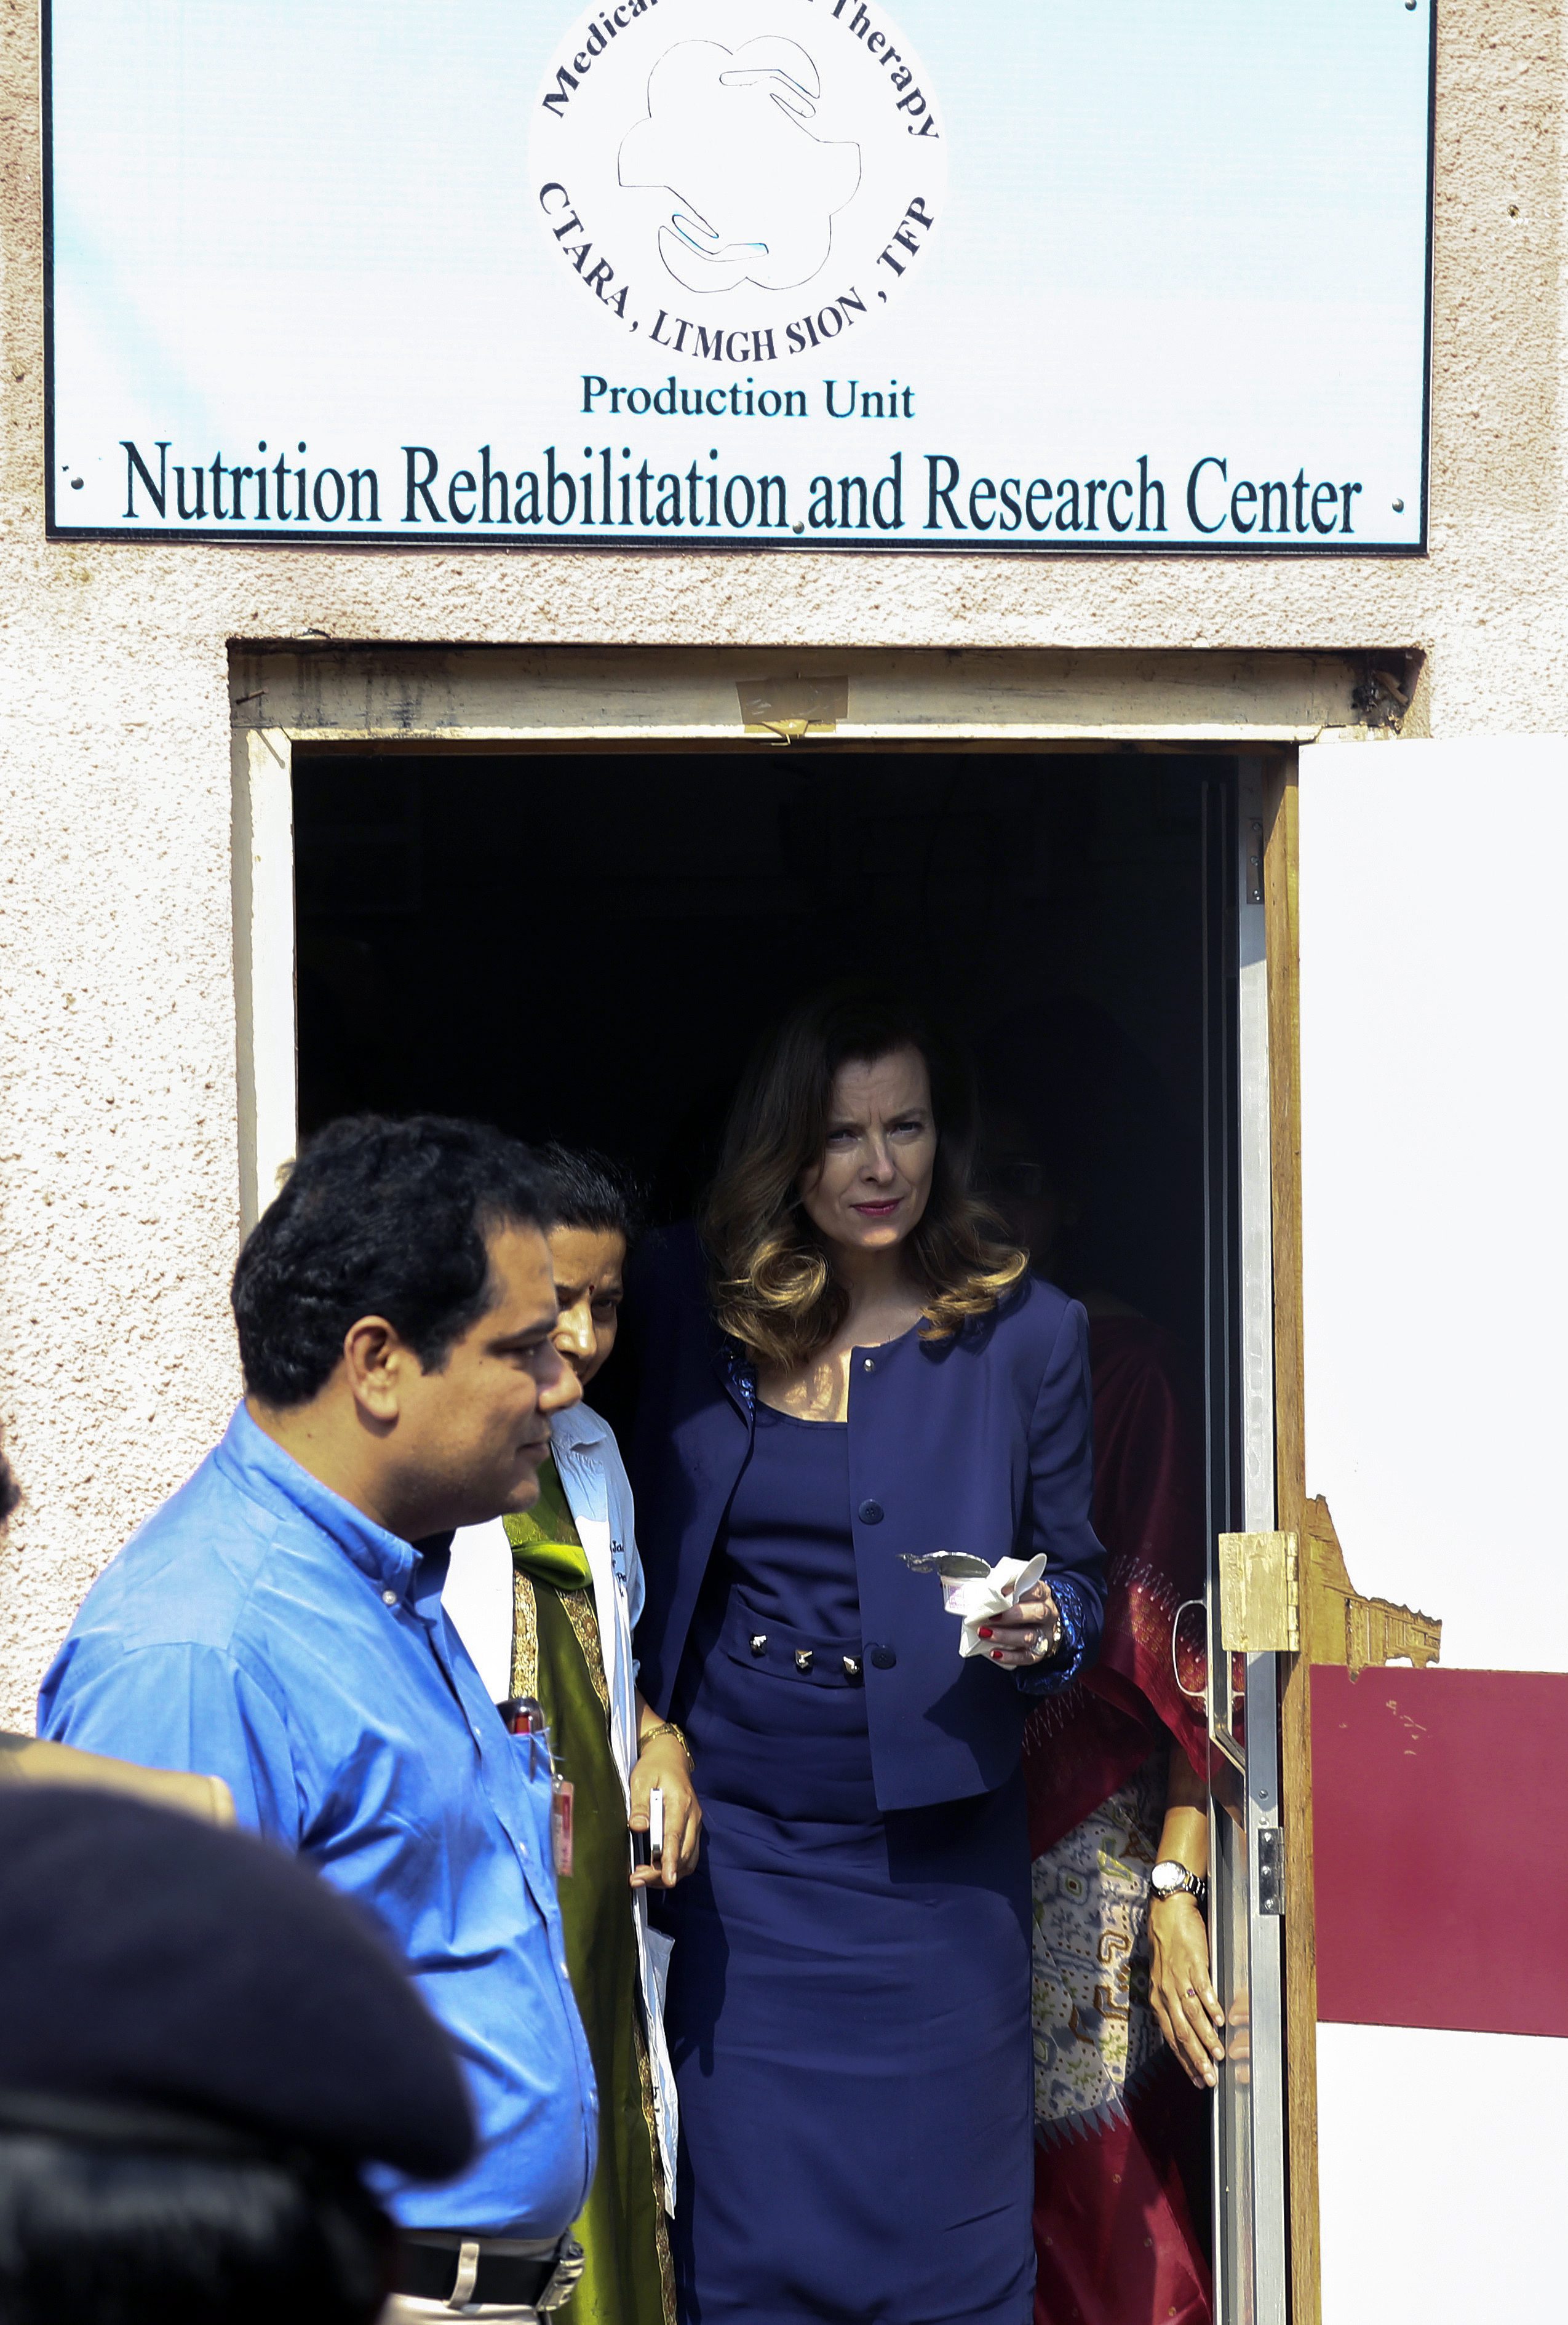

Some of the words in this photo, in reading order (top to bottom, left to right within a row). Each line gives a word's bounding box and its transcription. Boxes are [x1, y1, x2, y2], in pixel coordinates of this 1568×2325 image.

[542, 0, 658, 118] Medica
[648, 309, 778, 362] LTMGH
[876, 197, 934, 277] TFP
[581, 375, 808, 416] Production
[823, 380, 915, 418] Unit
[119, 441, 383, 523] Nutrition
[400, 444, 790, 529] Rehabilitation
[808, 451, 905, 531] and
[923, 454, 1169, 533] Research
[1186, 456, 1363, 534] Center
